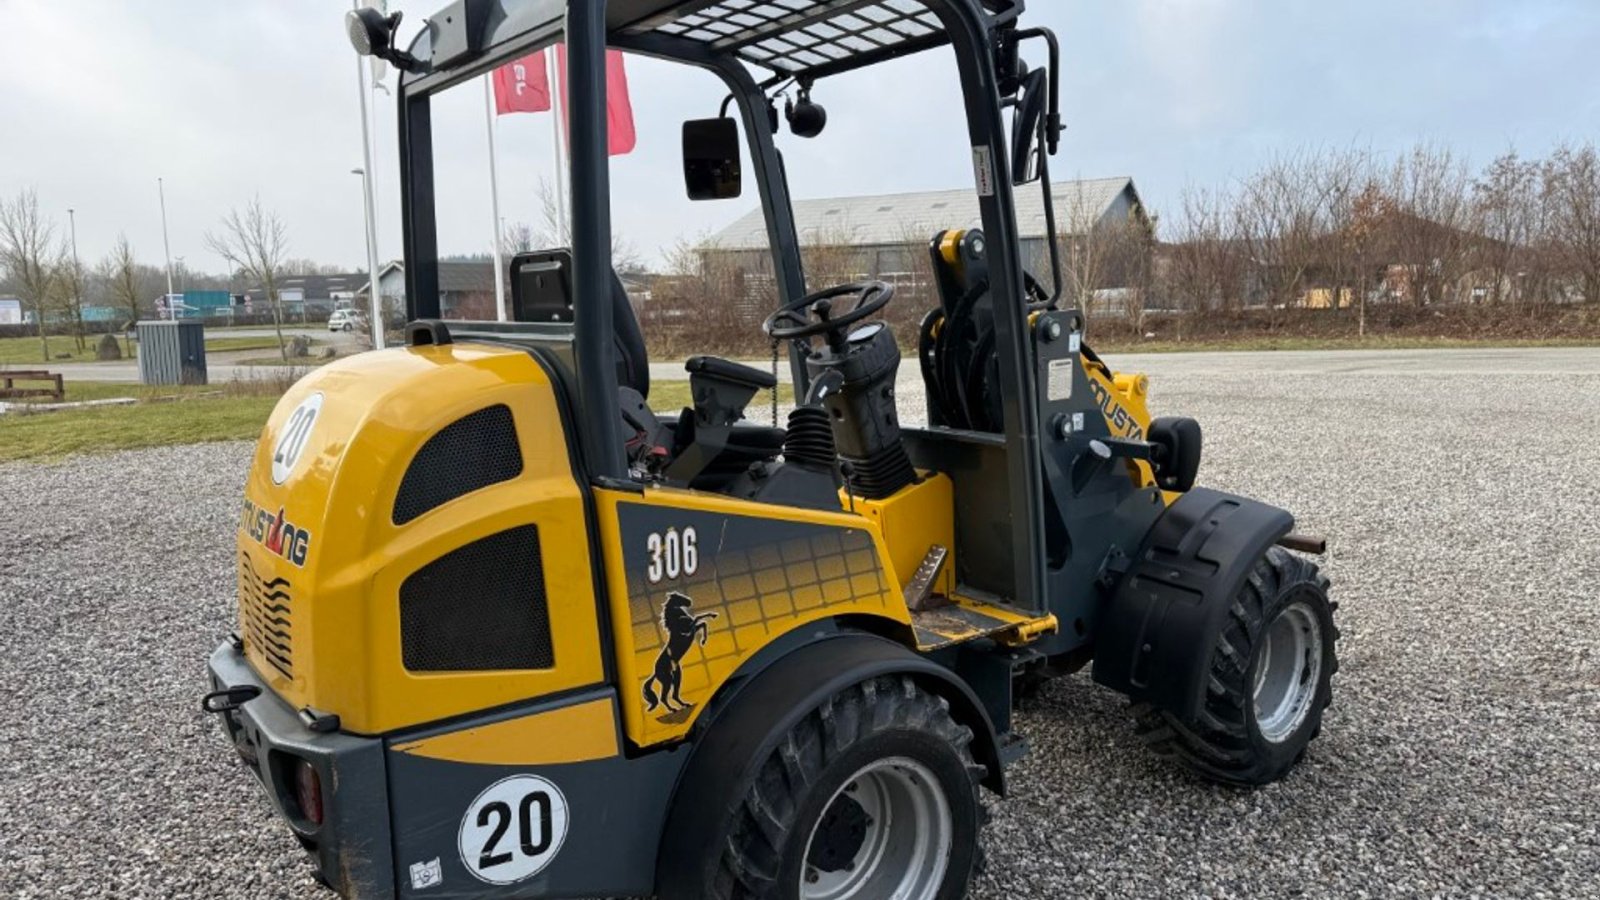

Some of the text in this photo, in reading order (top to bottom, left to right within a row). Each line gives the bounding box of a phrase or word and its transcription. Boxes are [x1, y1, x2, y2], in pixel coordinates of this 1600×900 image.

[275, 405, 317, 468] 20
[1088, 378, 1143, 440] MUSTA
[647, 526, 698, 583] 306
[477, 790, 552, 870] 20
